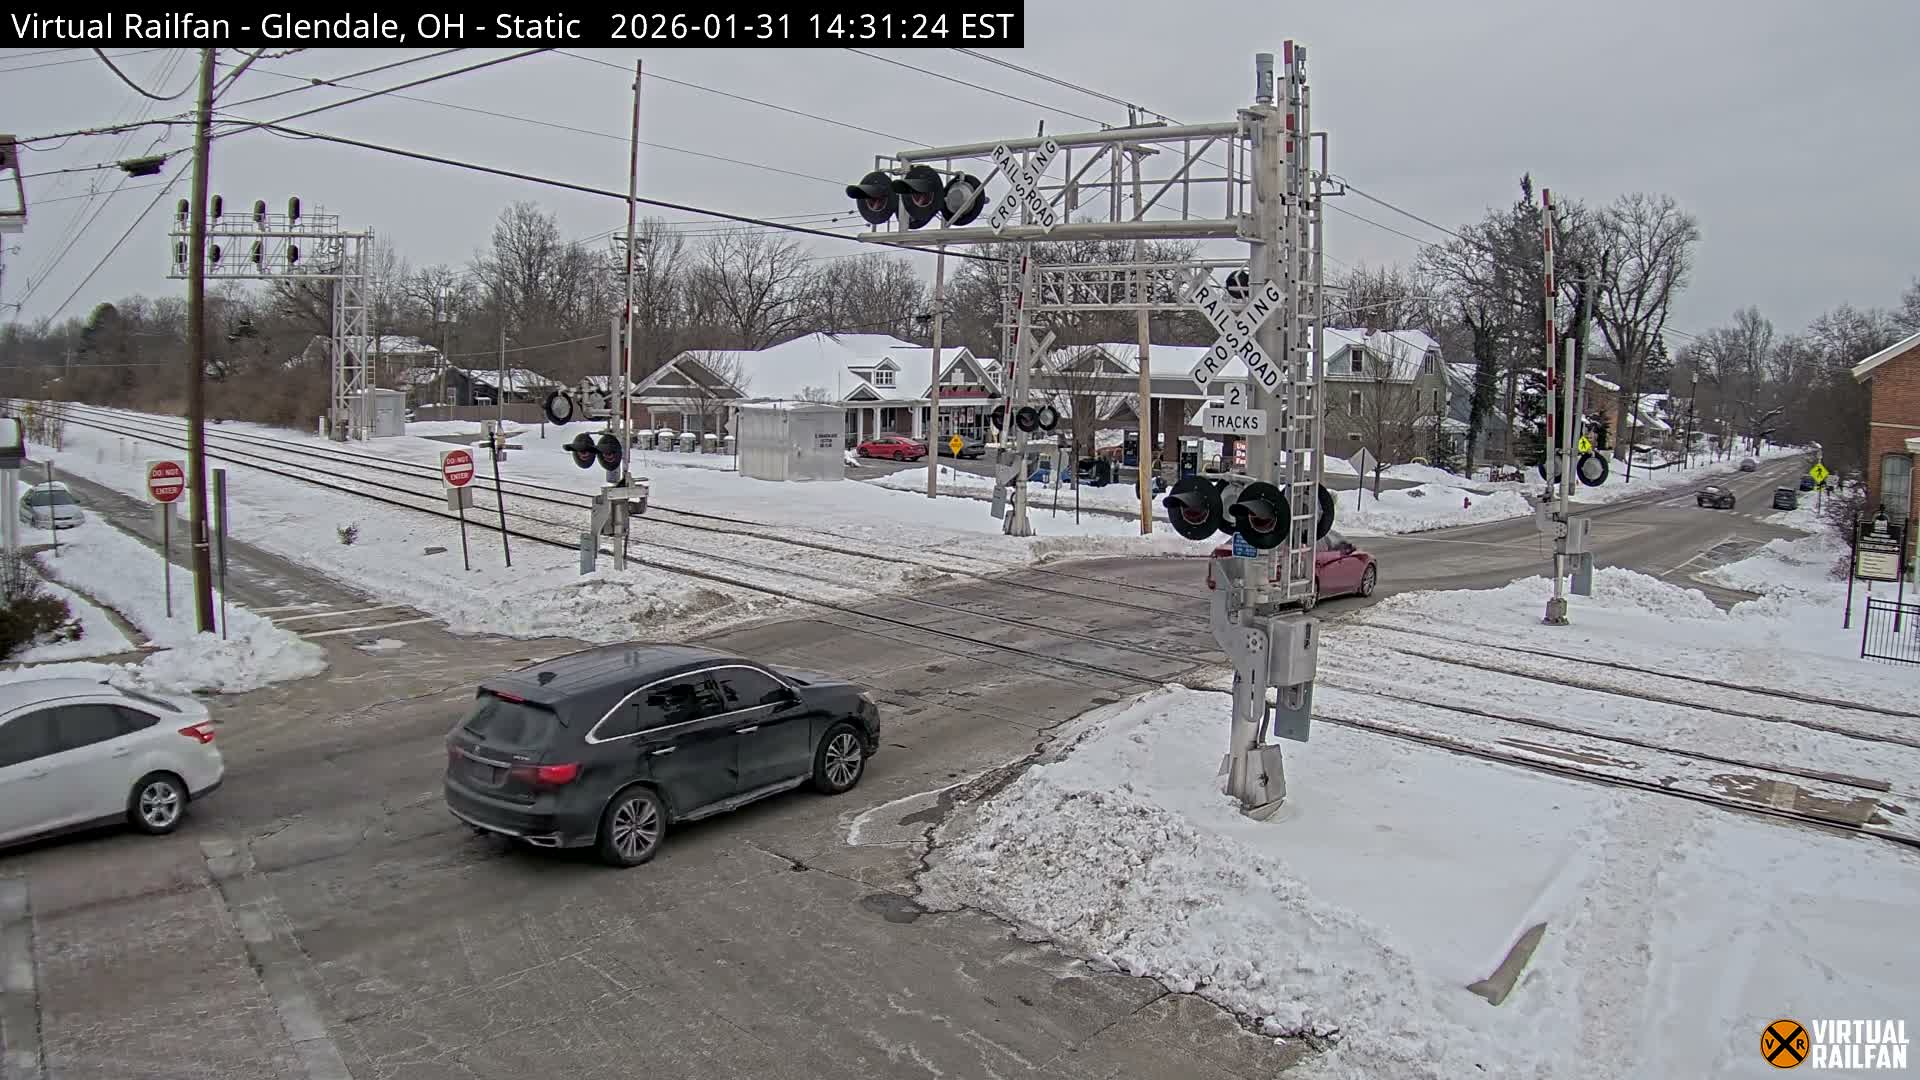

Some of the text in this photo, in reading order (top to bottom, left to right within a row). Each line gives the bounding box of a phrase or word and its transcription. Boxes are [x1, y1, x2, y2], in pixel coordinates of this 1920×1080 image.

[991, 141, 1056, 230] CROSSING
[1194, 286, 1280, 384] CROSSING
[1230, 387, 1240, 405] 2
[1210, 414, 1259, 430] TRACKS
[152, 468, 178, 477] DO NOT
[450, 472, 469, 481] ENTER
[155, 487, 177, 495] ENTER
